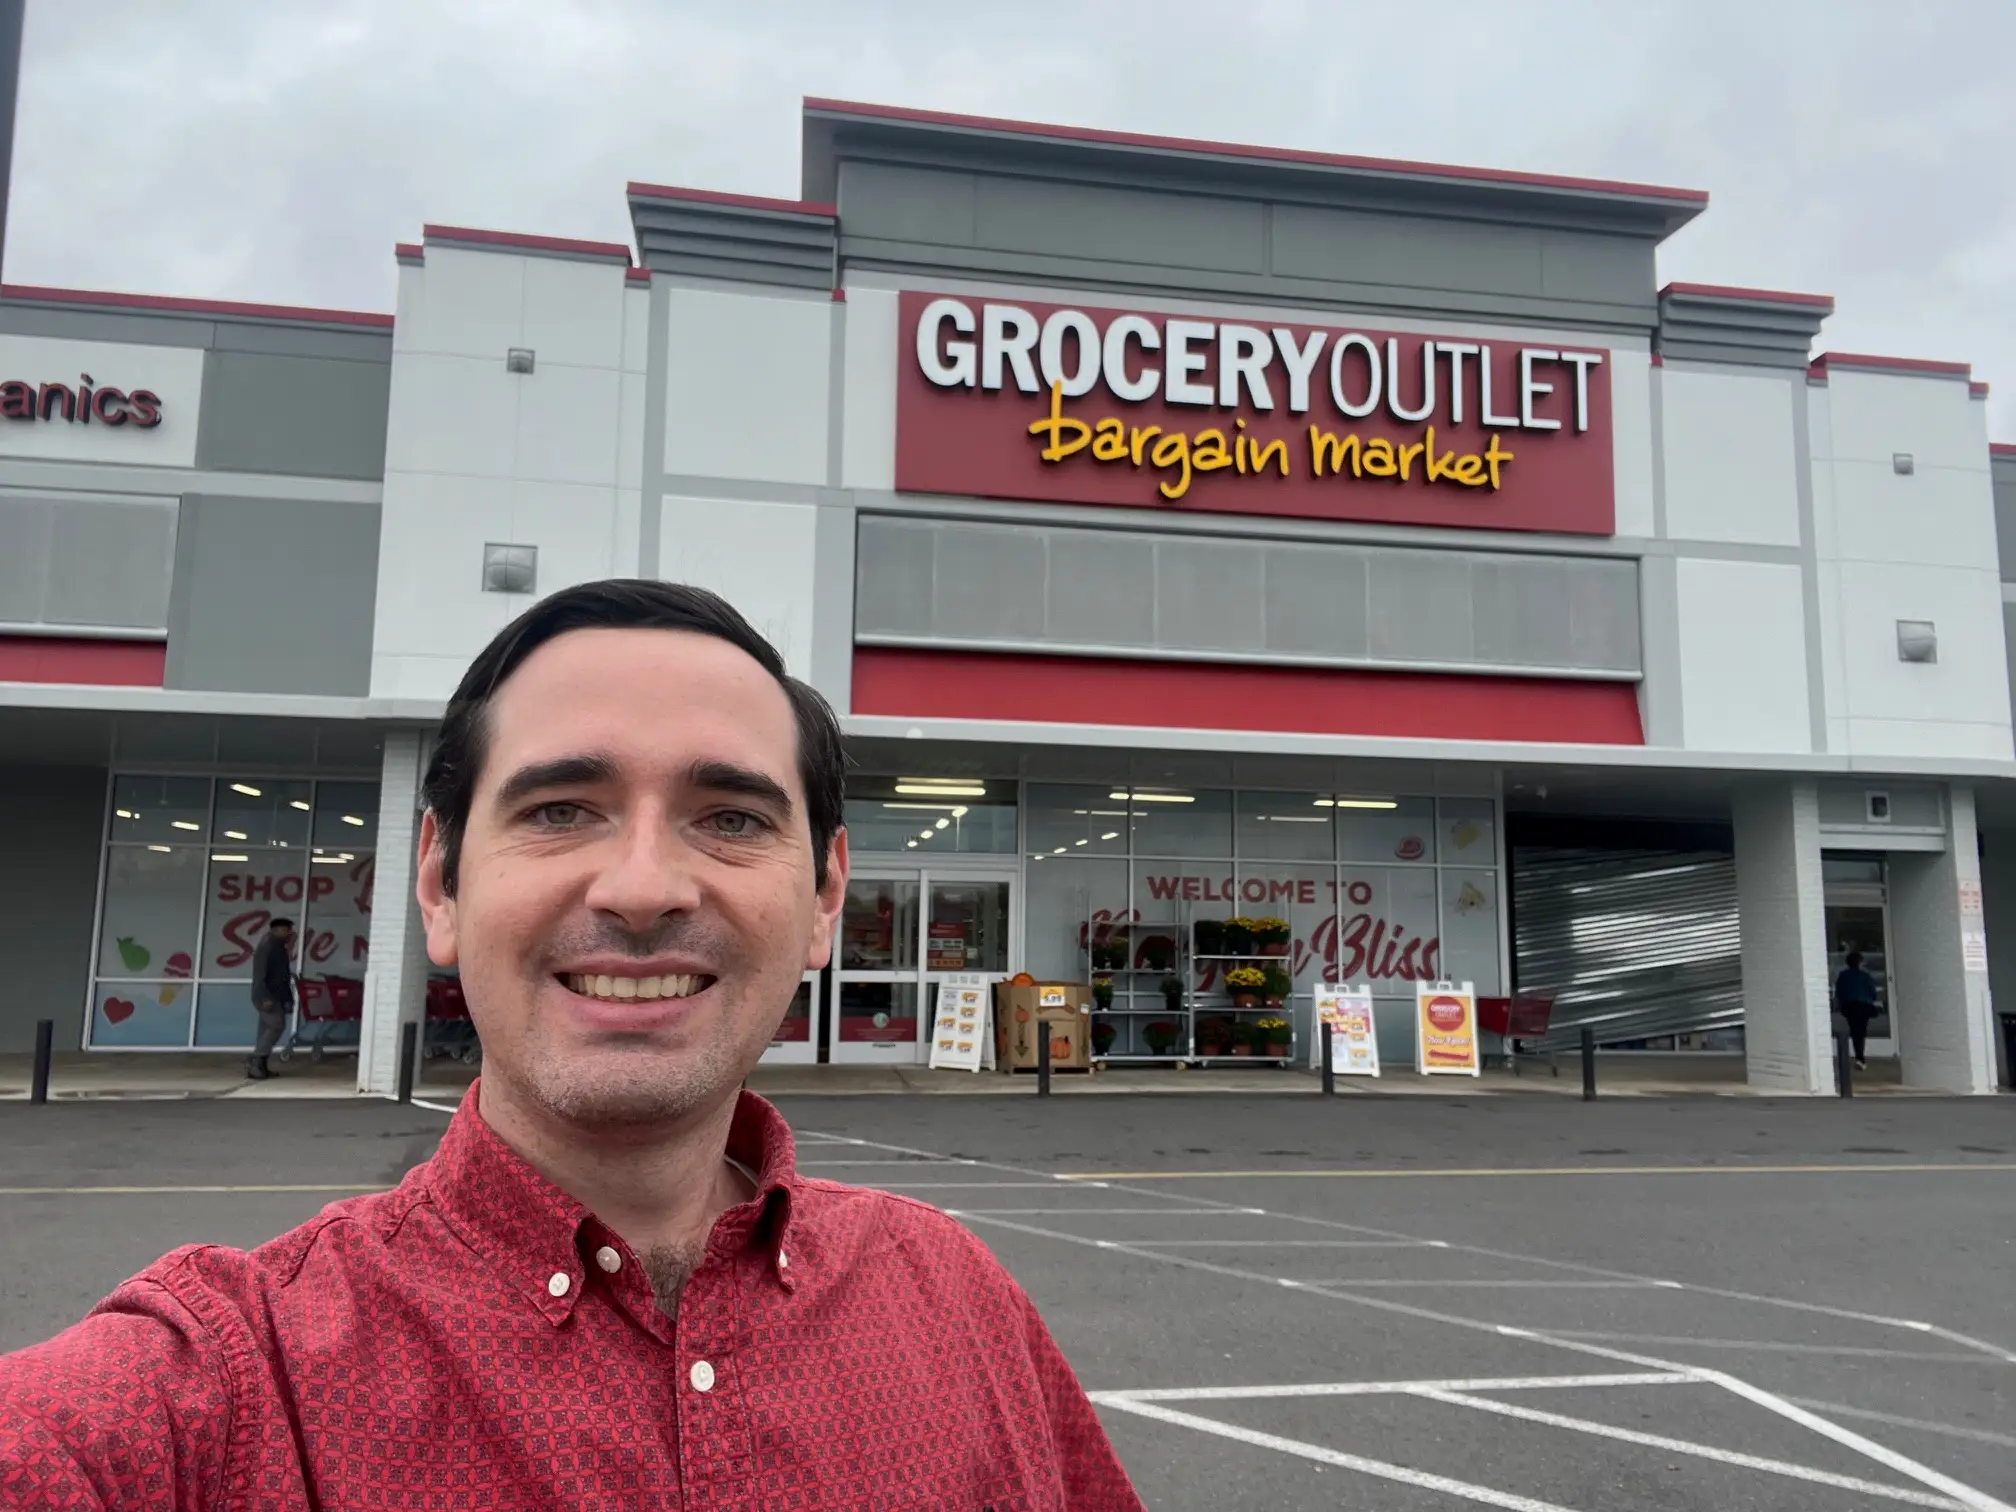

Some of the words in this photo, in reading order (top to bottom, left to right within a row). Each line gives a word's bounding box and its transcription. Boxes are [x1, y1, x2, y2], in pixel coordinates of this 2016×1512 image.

[1029, 380, 1290, 499] bargain
[1309, 424, 1515, 490] market
[217, 874, 335, 903] SHOP
[1146, 876, 1316, 904] WELCOME
[1325, 880, 1373, 905] TO
[1310, 913, 1441, 983] Bliss
